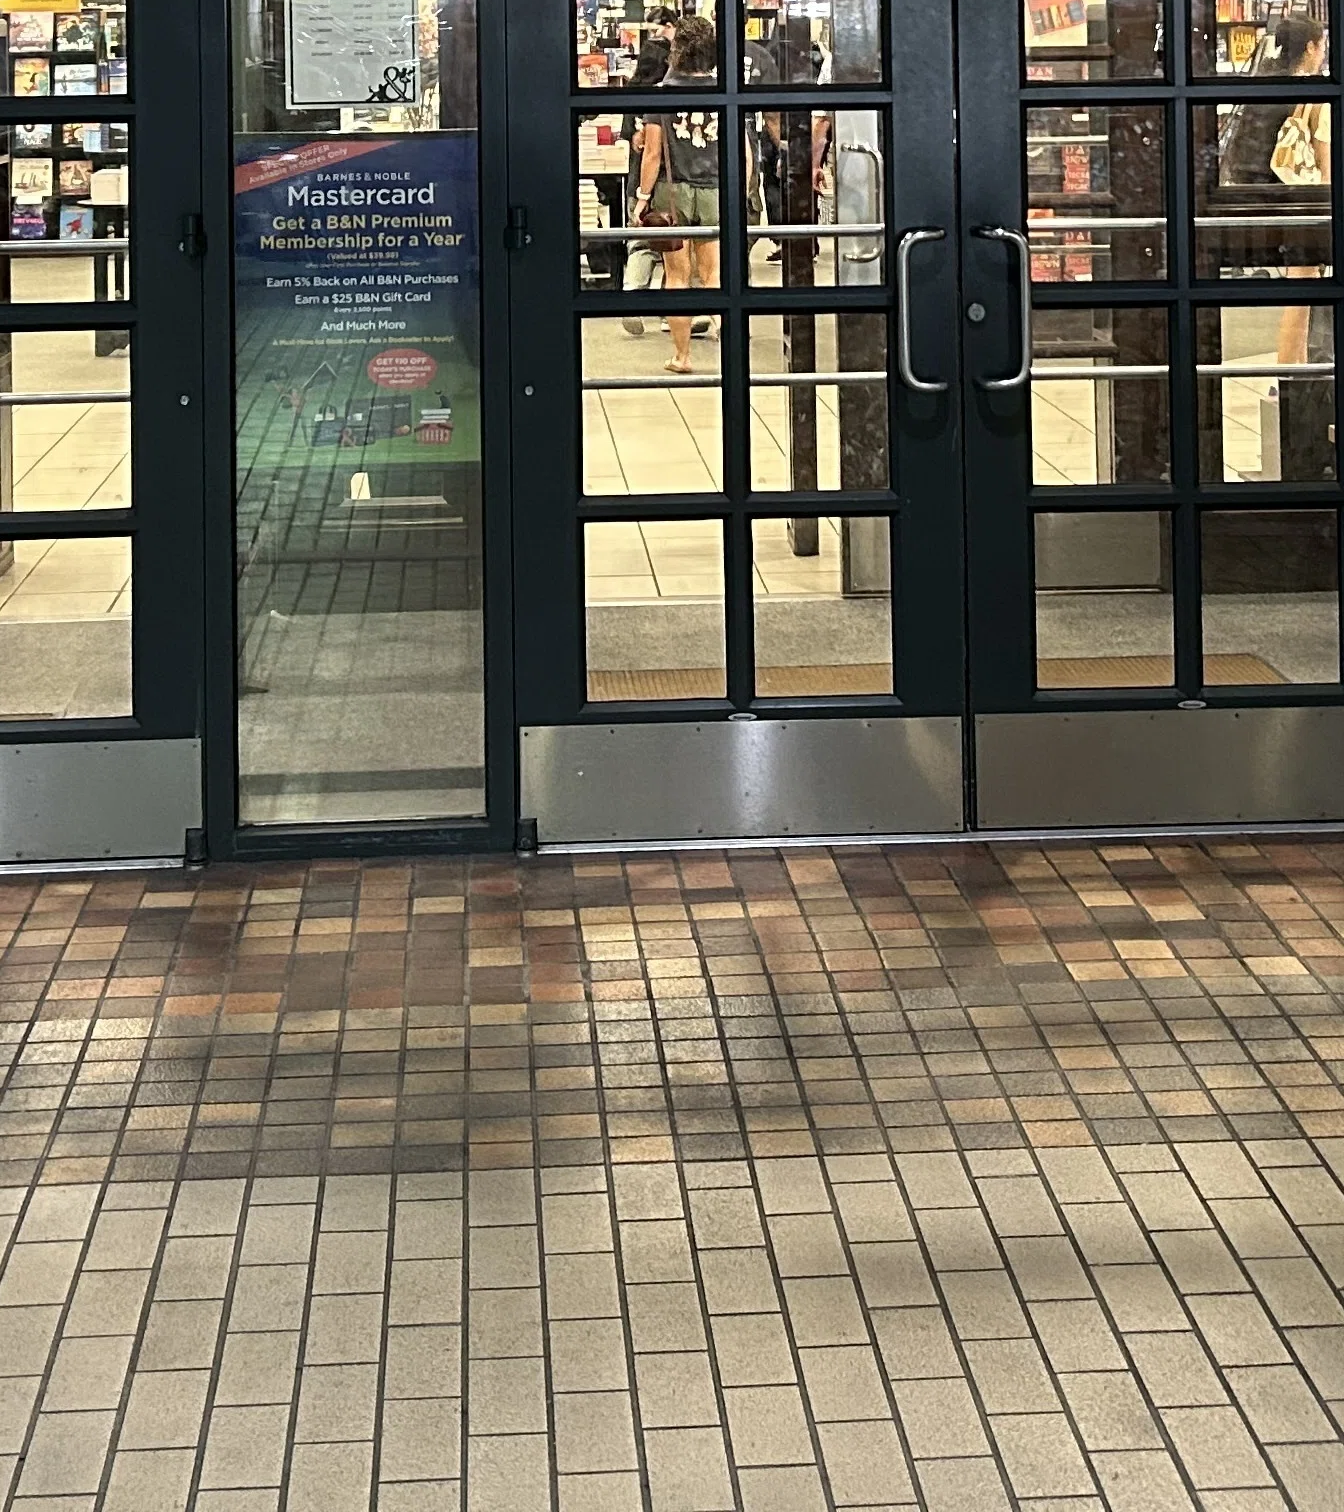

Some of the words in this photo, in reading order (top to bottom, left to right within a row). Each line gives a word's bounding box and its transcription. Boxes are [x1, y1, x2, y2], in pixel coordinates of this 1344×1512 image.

[317, 173, 362, 182] BARNES
[374, 172, 411, 180] NOBLE
[287, 183, 434, 207] Mastercard
[272, 216, 305, 231] Get
[310, 220, 321, 230] a
[326, 215, 366, 229] B&N
[371, 214, 452, 228] Premium
[260, 234, 373, 250] Membership
[378, 232, 404, 247] for
[408, 236, 419, 246] a
[423, 232, 462, 246] Year
[266, 278, 291, 288] Earn
[294, 277, 311, 287] 5%
[313, 276, 340, 287] Back
[359, 275, 375, 285] All
[377, 275, 401, 285] B&N
[404, 274, 458, 284] Purchases
[294, 294, 320, 305] Earn
[331, 293, 352, 304] $25
[355, 293, 380, 303] B&N
[382, 292, 402, 302] Gift
[404, 292, 431, 302] Card
[320, 320, 343, 331] And
[346, 319, 375, 331] Much
[378, 319, 406, 330] More
[376, 357, 393, 365] GET
[410, 356, 427, 364] OFF
